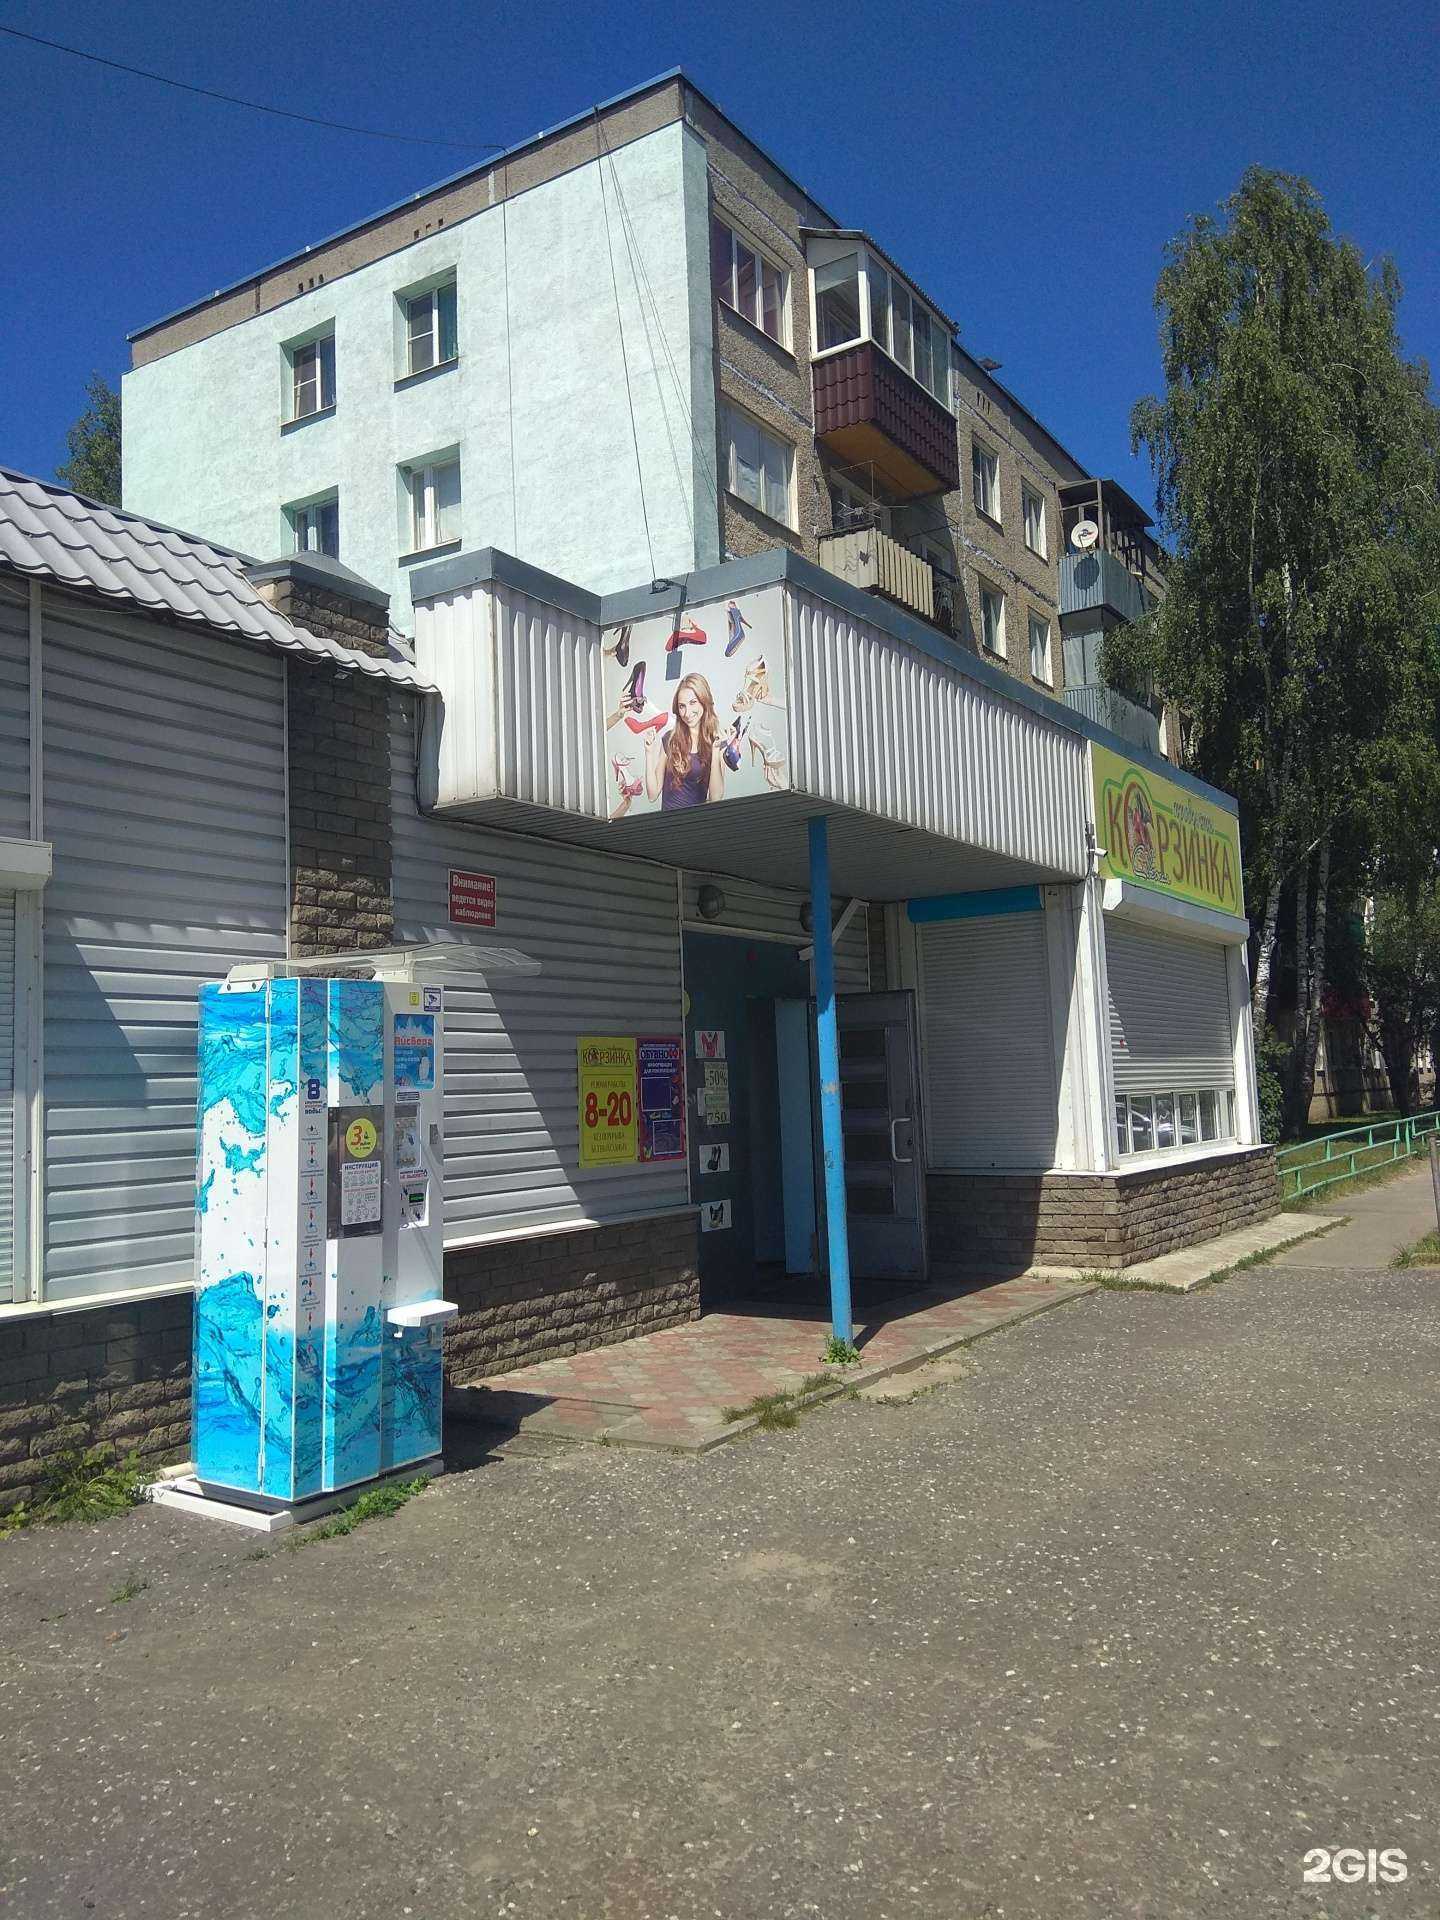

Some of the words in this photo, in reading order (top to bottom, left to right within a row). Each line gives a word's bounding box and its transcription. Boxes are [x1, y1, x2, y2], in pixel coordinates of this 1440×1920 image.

[1107, 781, 1237, 902] КОРЗИНКА
[452, 874, 494, 892] Внимание!
[583, 1048, 631, 1065] КОРЗИНКА
[706, 1070, 728, 1086] -50%
[585, 1091, 632, 1128] 8-20
